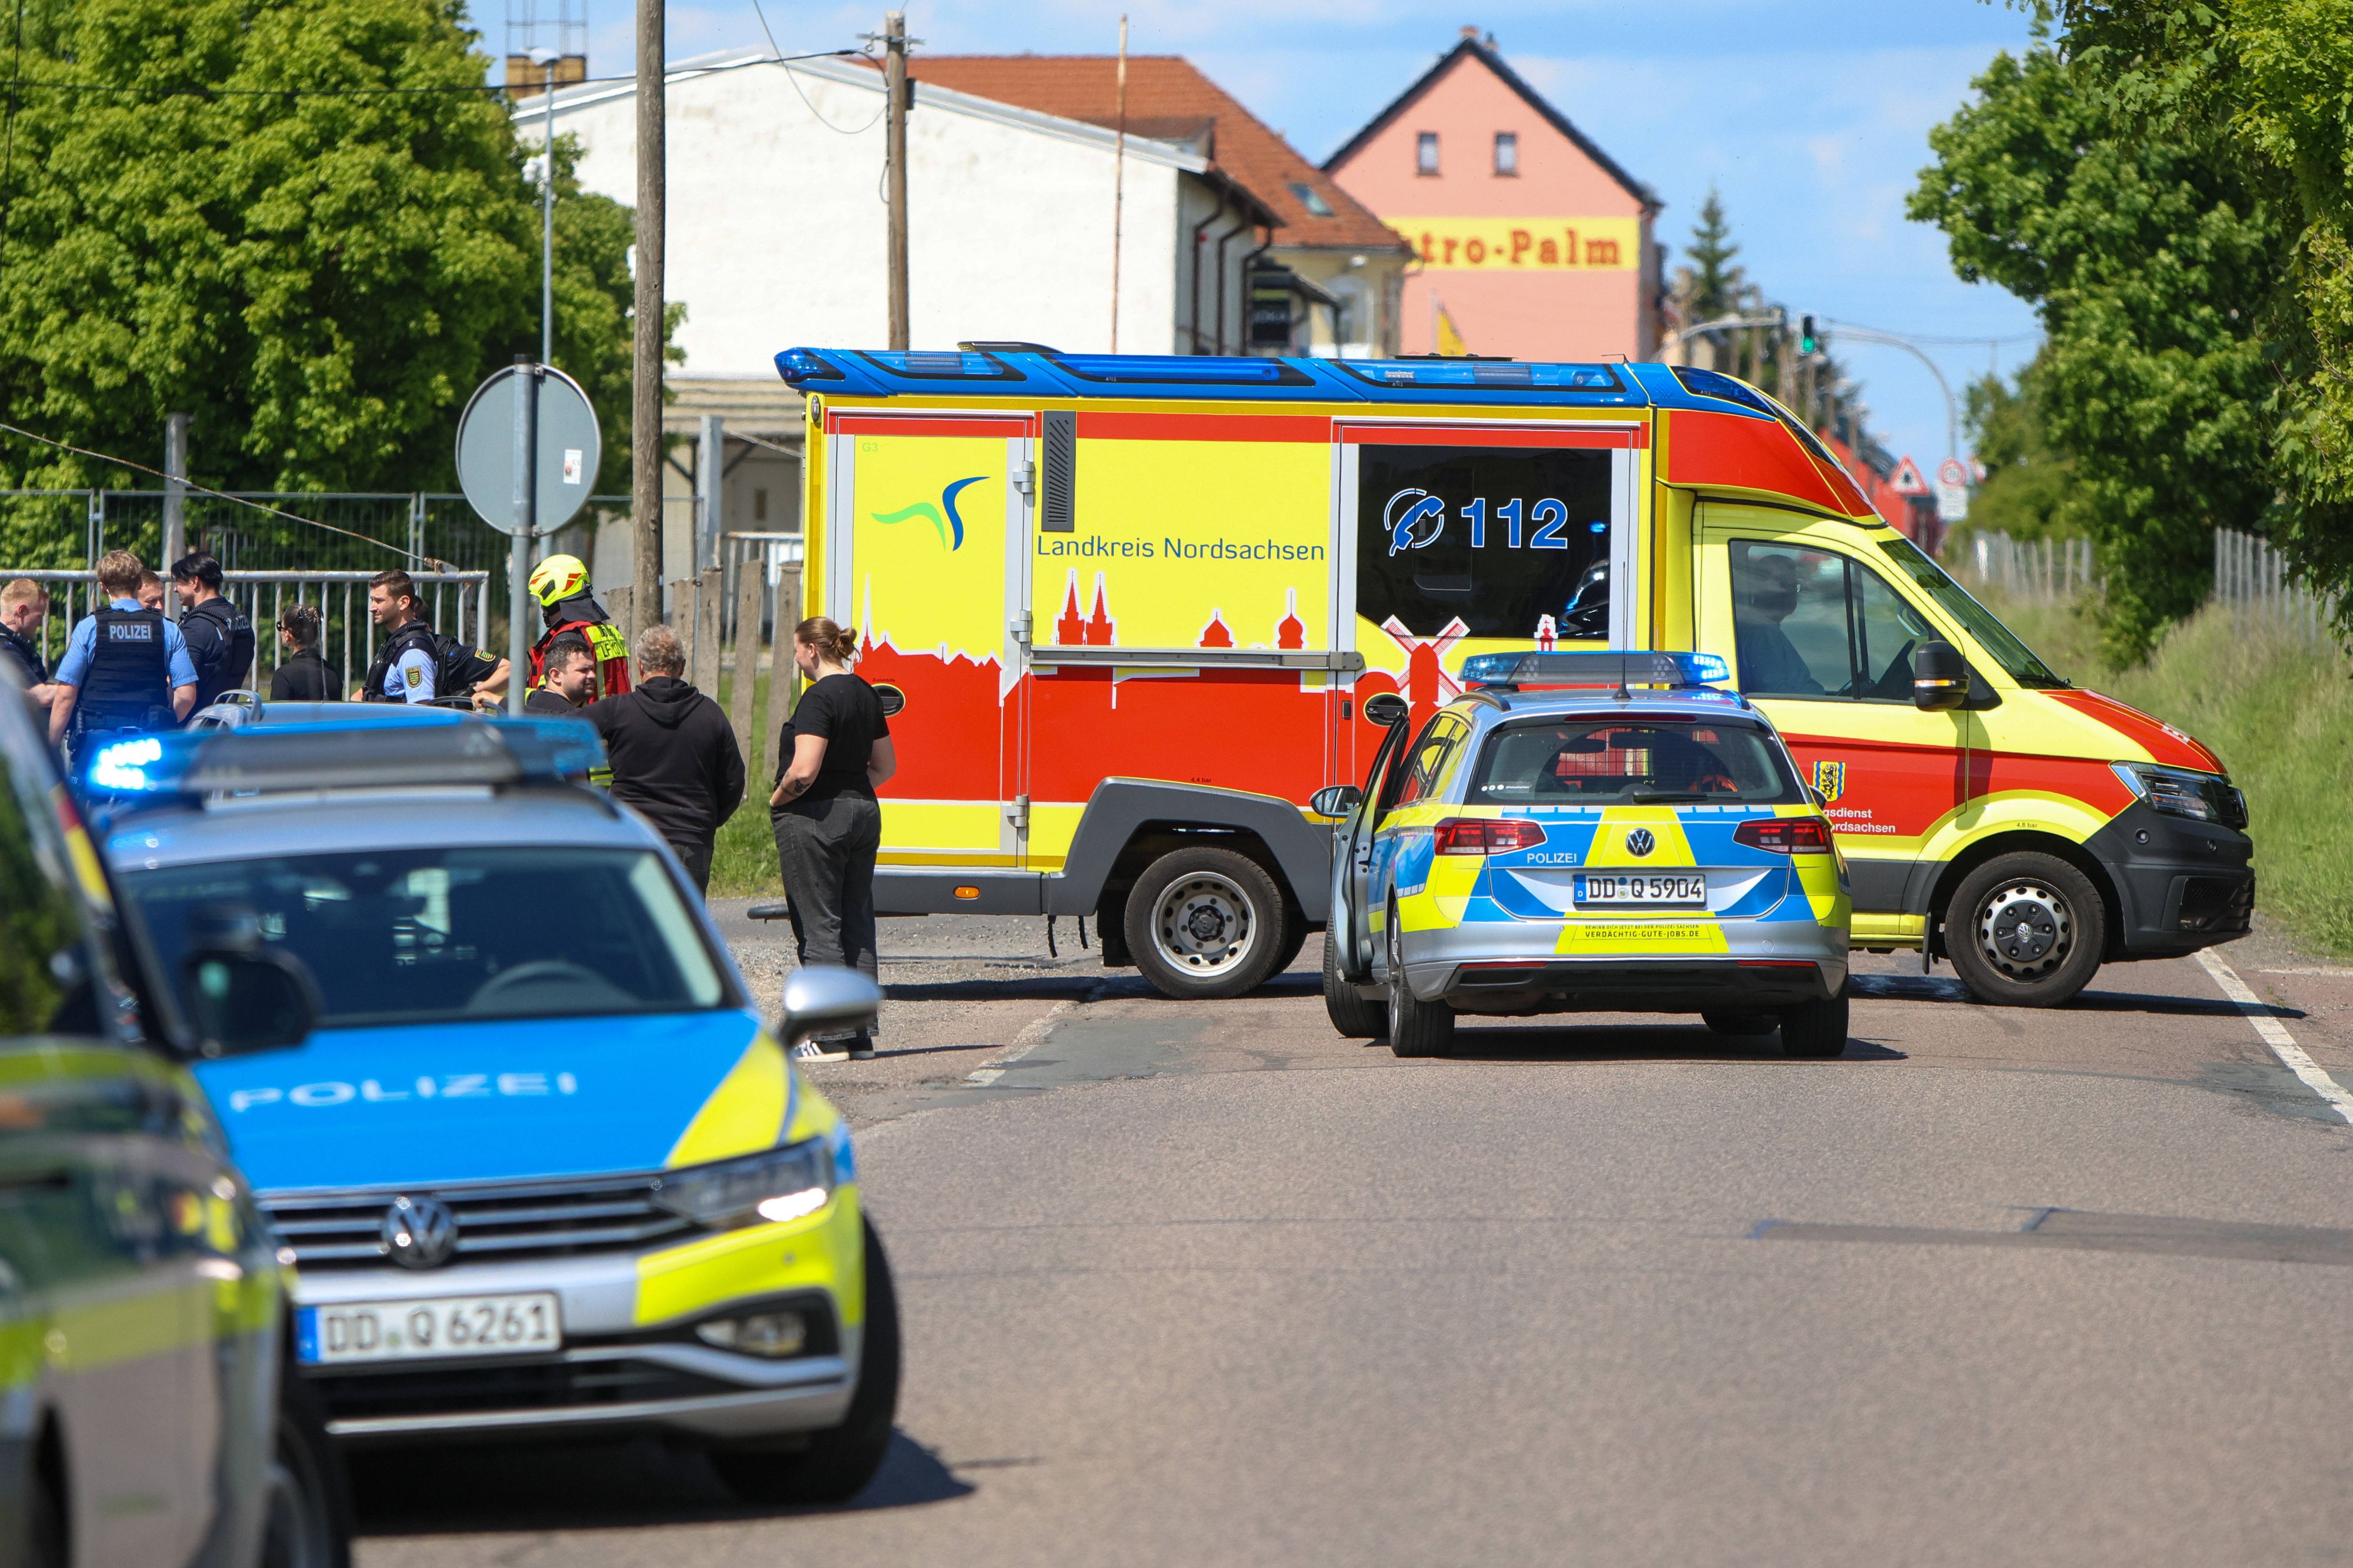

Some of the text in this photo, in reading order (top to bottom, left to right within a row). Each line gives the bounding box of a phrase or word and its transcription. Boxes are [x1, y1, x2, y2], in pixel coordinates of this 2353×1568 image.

[862, 442, 878, 452] G3
[1461, 498, 1568, 549] 112
[1038, 535, 1324, 561] Landkreis Nordsachsen
[110, 625, 151, 639] POLIZEI
[1823, 808, 1872, 818] gsdienst
[1832, 822, 1896, 833] rdsachsen
[1527, 853, 1577, 863] POLIZEI
[1589, 878, 1615, 898] DD
[1631, 878, 1644, 898] Q
[1650, 878, 1701, 898] 5904
[1585, 930, 1699, 938] VERDÄCHTIG-GUTE-JOBS.DE
[229, 1071, 578, 1113] POLIZEI
[326, 1302, 548, 1352] DD Q 6261
